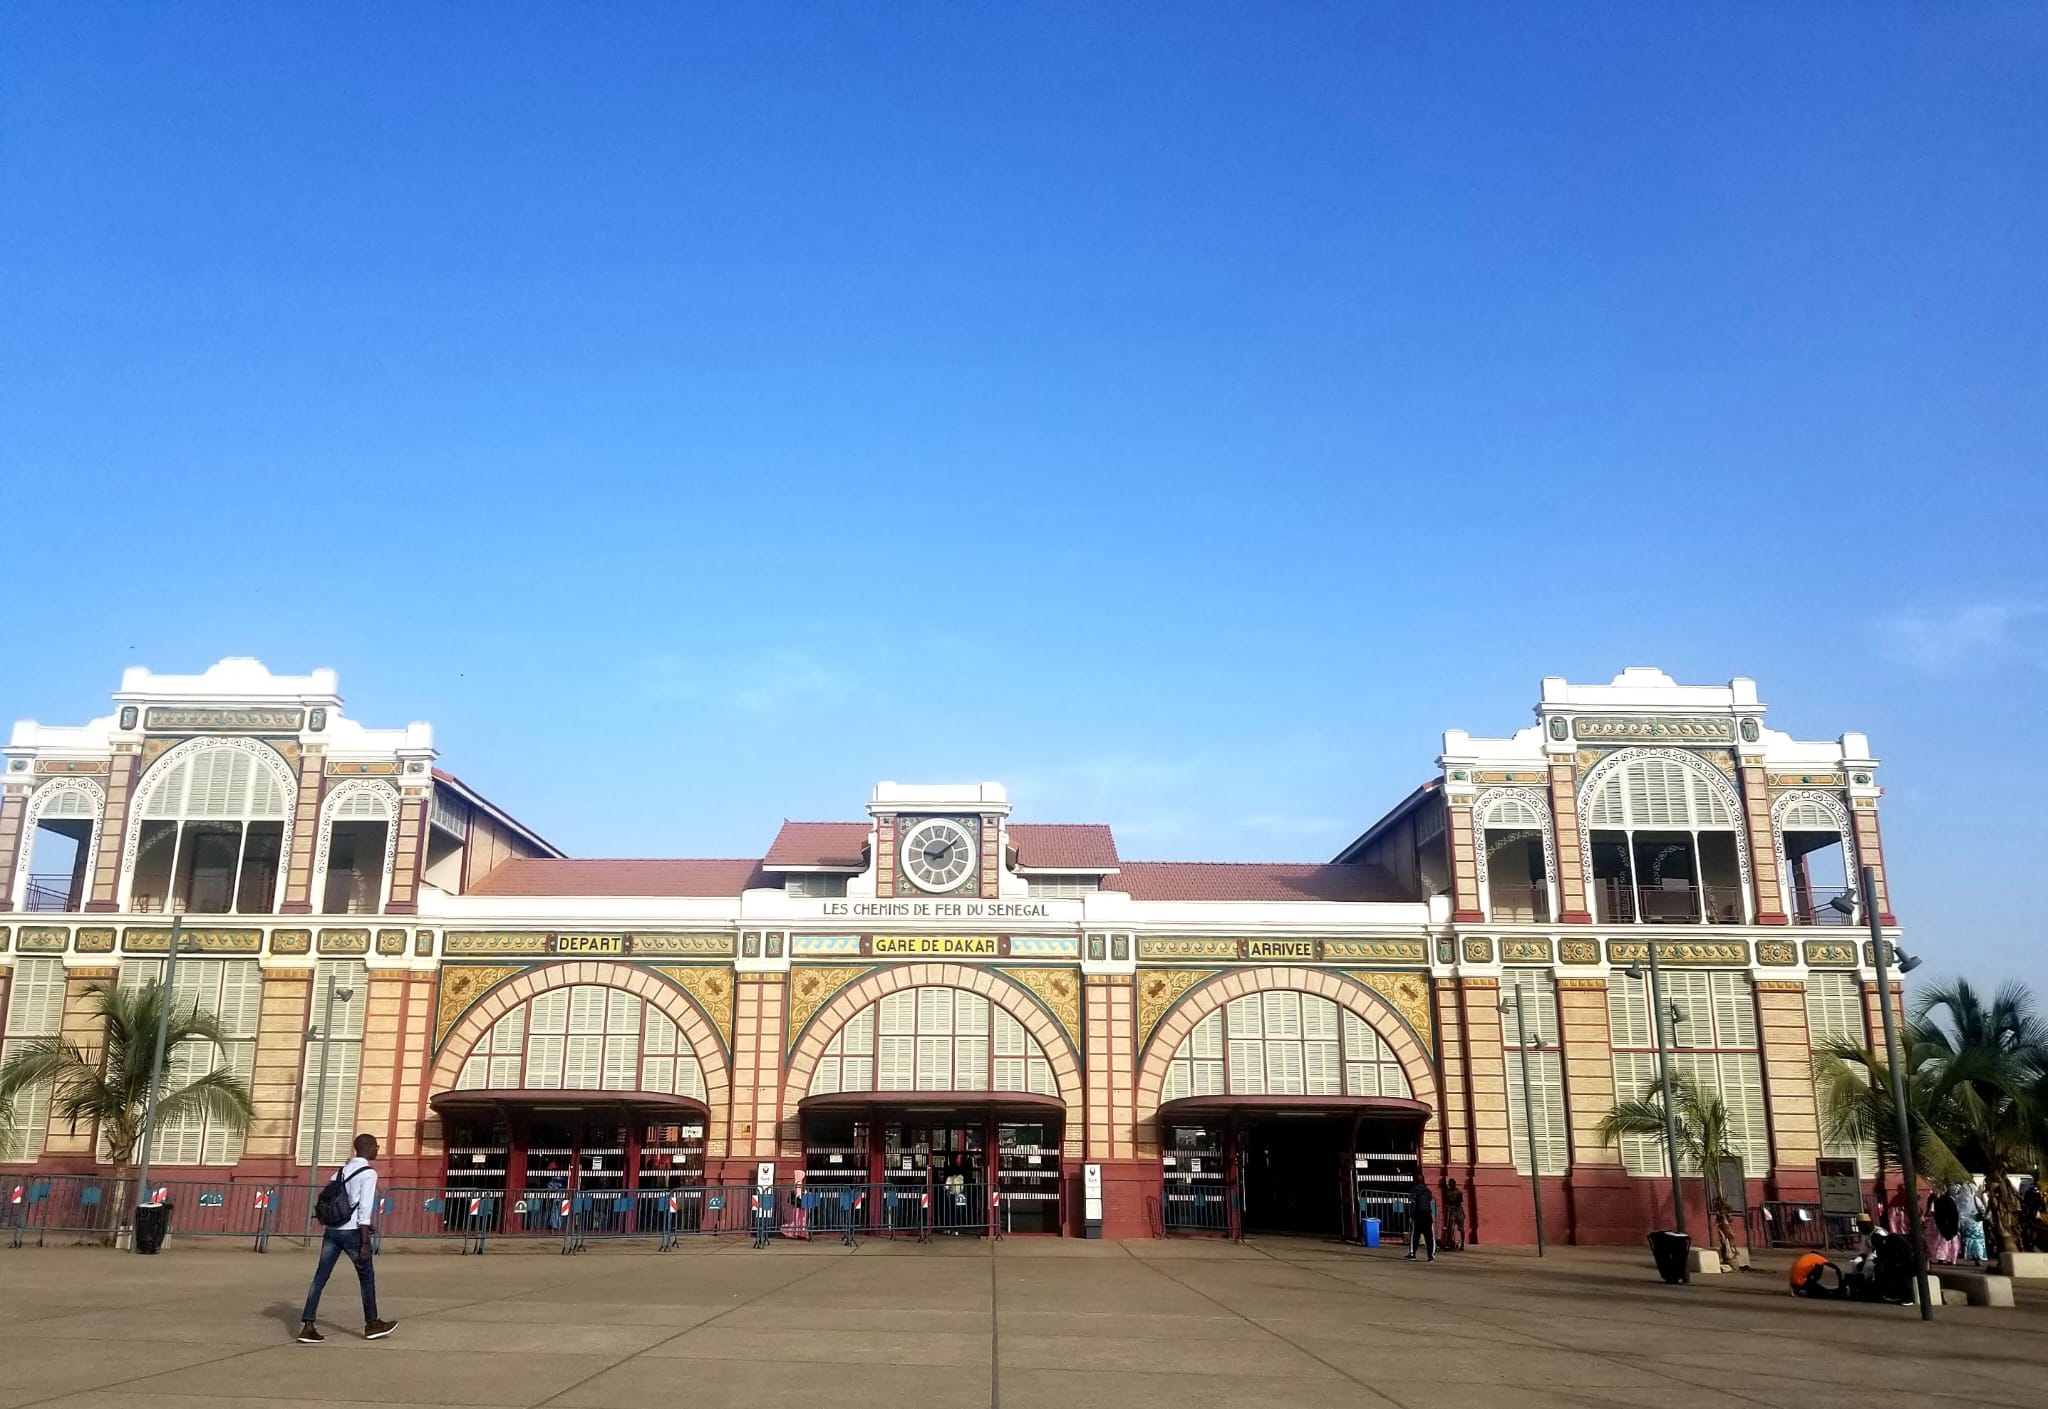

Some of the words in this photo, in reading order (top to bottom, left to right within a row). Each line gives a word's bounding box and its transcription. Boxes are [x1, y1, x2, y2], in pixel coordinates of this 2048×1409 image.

[823, 903, 849, 915] LES
[853, 903, 909, 916] CHEMINS
[913, 904, 930, 916] DE
[935, 904, 962, 916] FER
[967, 904, 983, 916] DU
[987, 904, 1049, 917] SENEGAL
[559, 937, 621, 951] DEPART
[876, 939, 916, 952] GARE
[921, 940, 940, 952] DE
[944, 939, 995, 953] DAKAR
[1251, 942, 1311, 956] ARRIVEE
